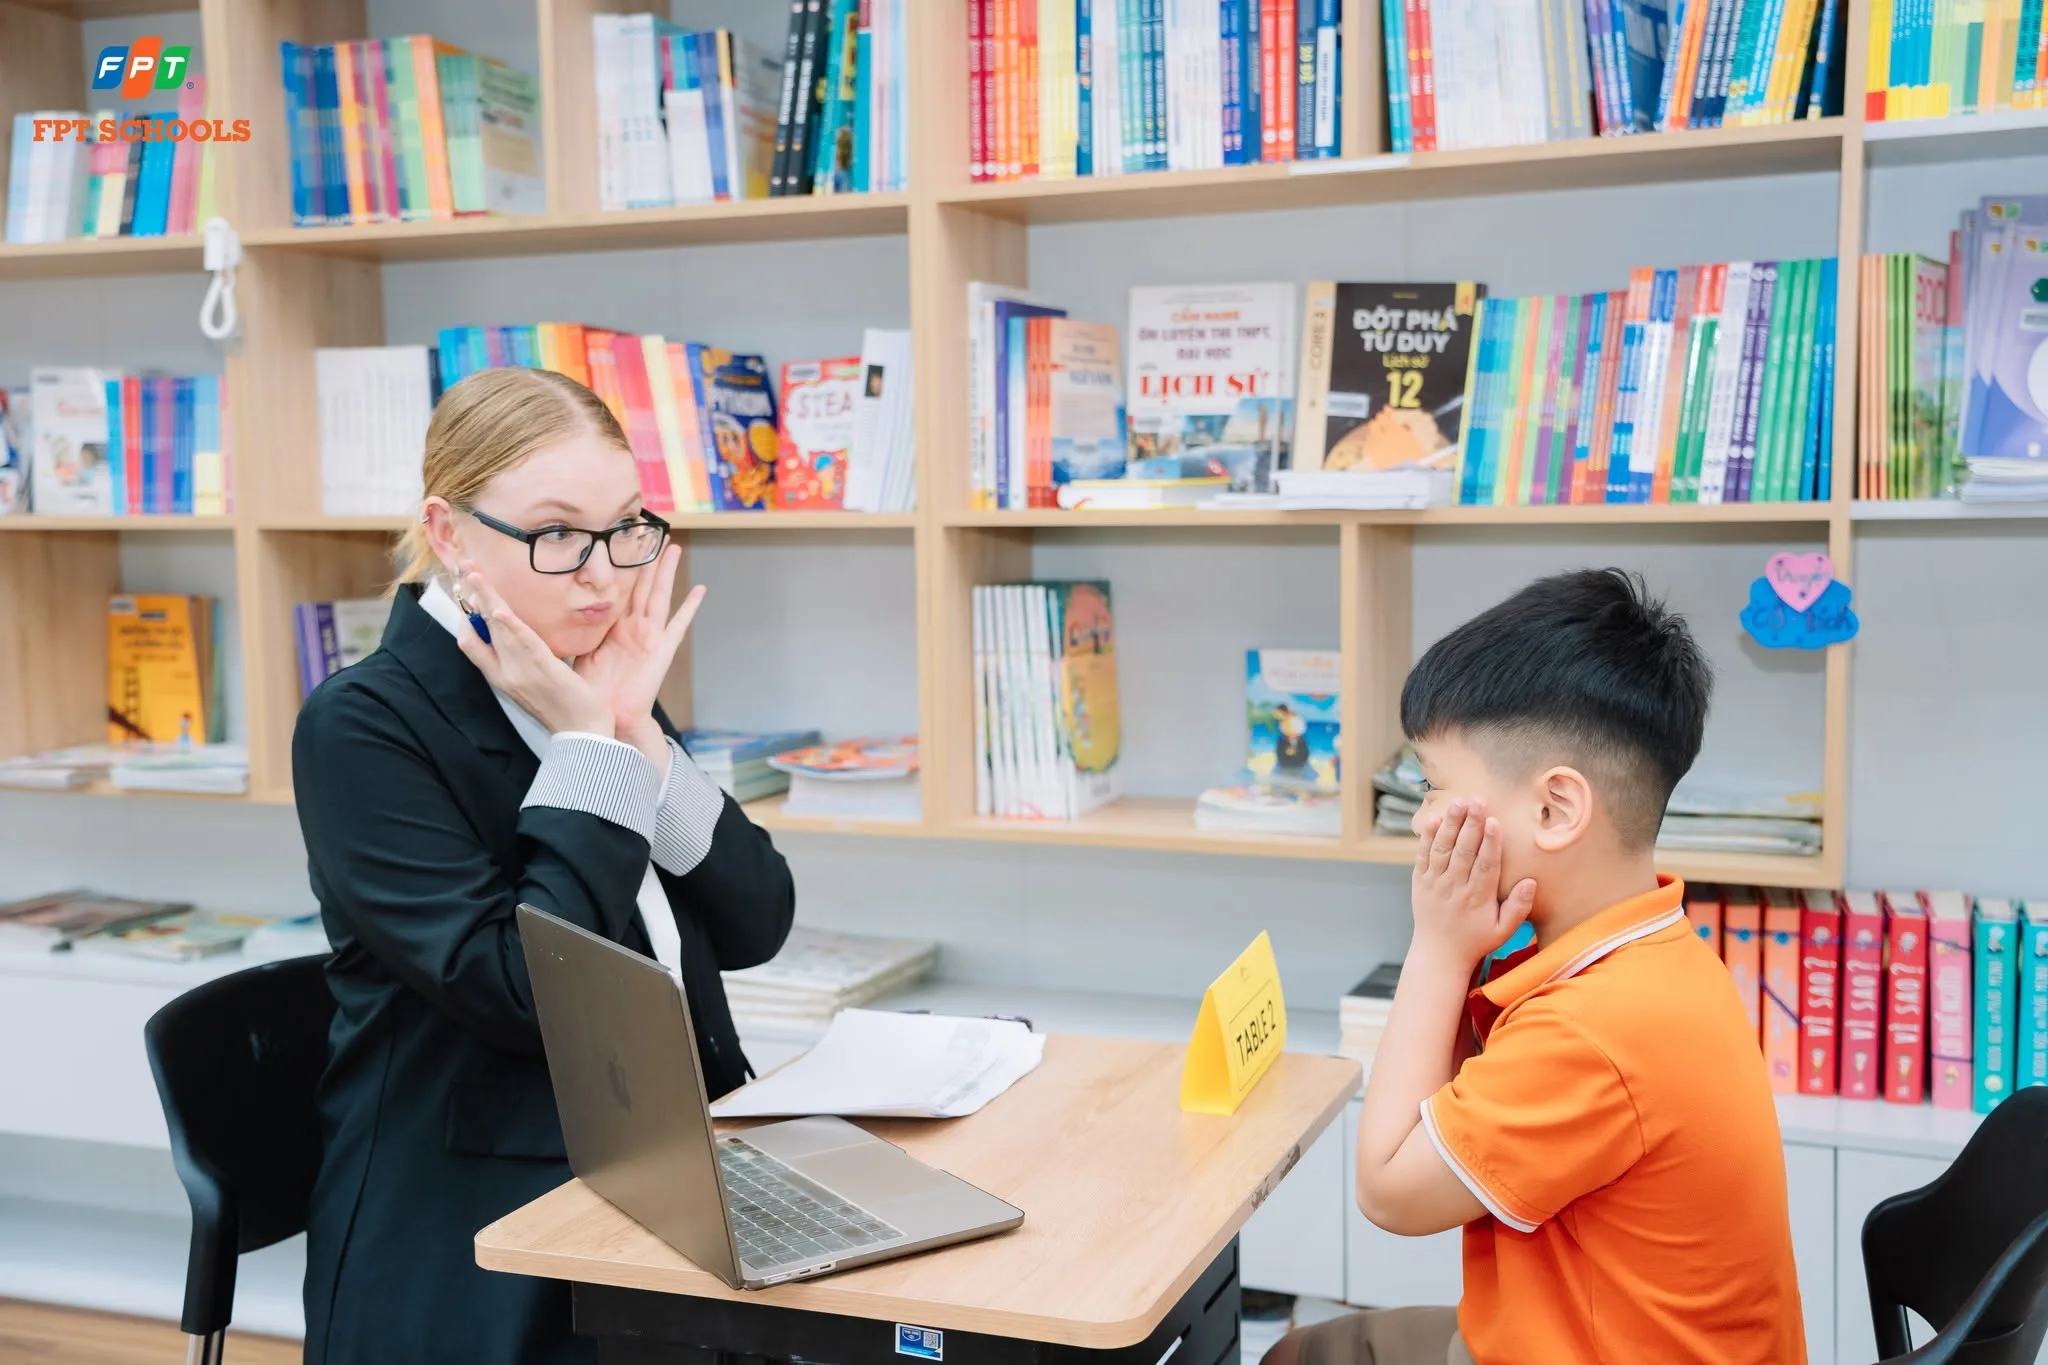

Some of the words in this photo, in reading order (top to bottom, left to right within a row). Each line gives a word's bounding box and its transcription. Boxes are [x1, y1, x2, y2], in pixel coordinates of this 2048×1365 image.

[1397, 332, 1451, 353] DUY
[797, 391, 853, 418] STEA
[1140, 375, 1214, 407] LỊCH
[1386, 369, 1424, 408] 12
[1803, 956, 1837, 1009] SAO?
[1846, 959, 1881, 1012] SAO?
[1889, 962, 1925, 1015] SAO?
[1236, 1008, 1268, 1067] TABLE
[1267, 999, 1276, 1030] 2
